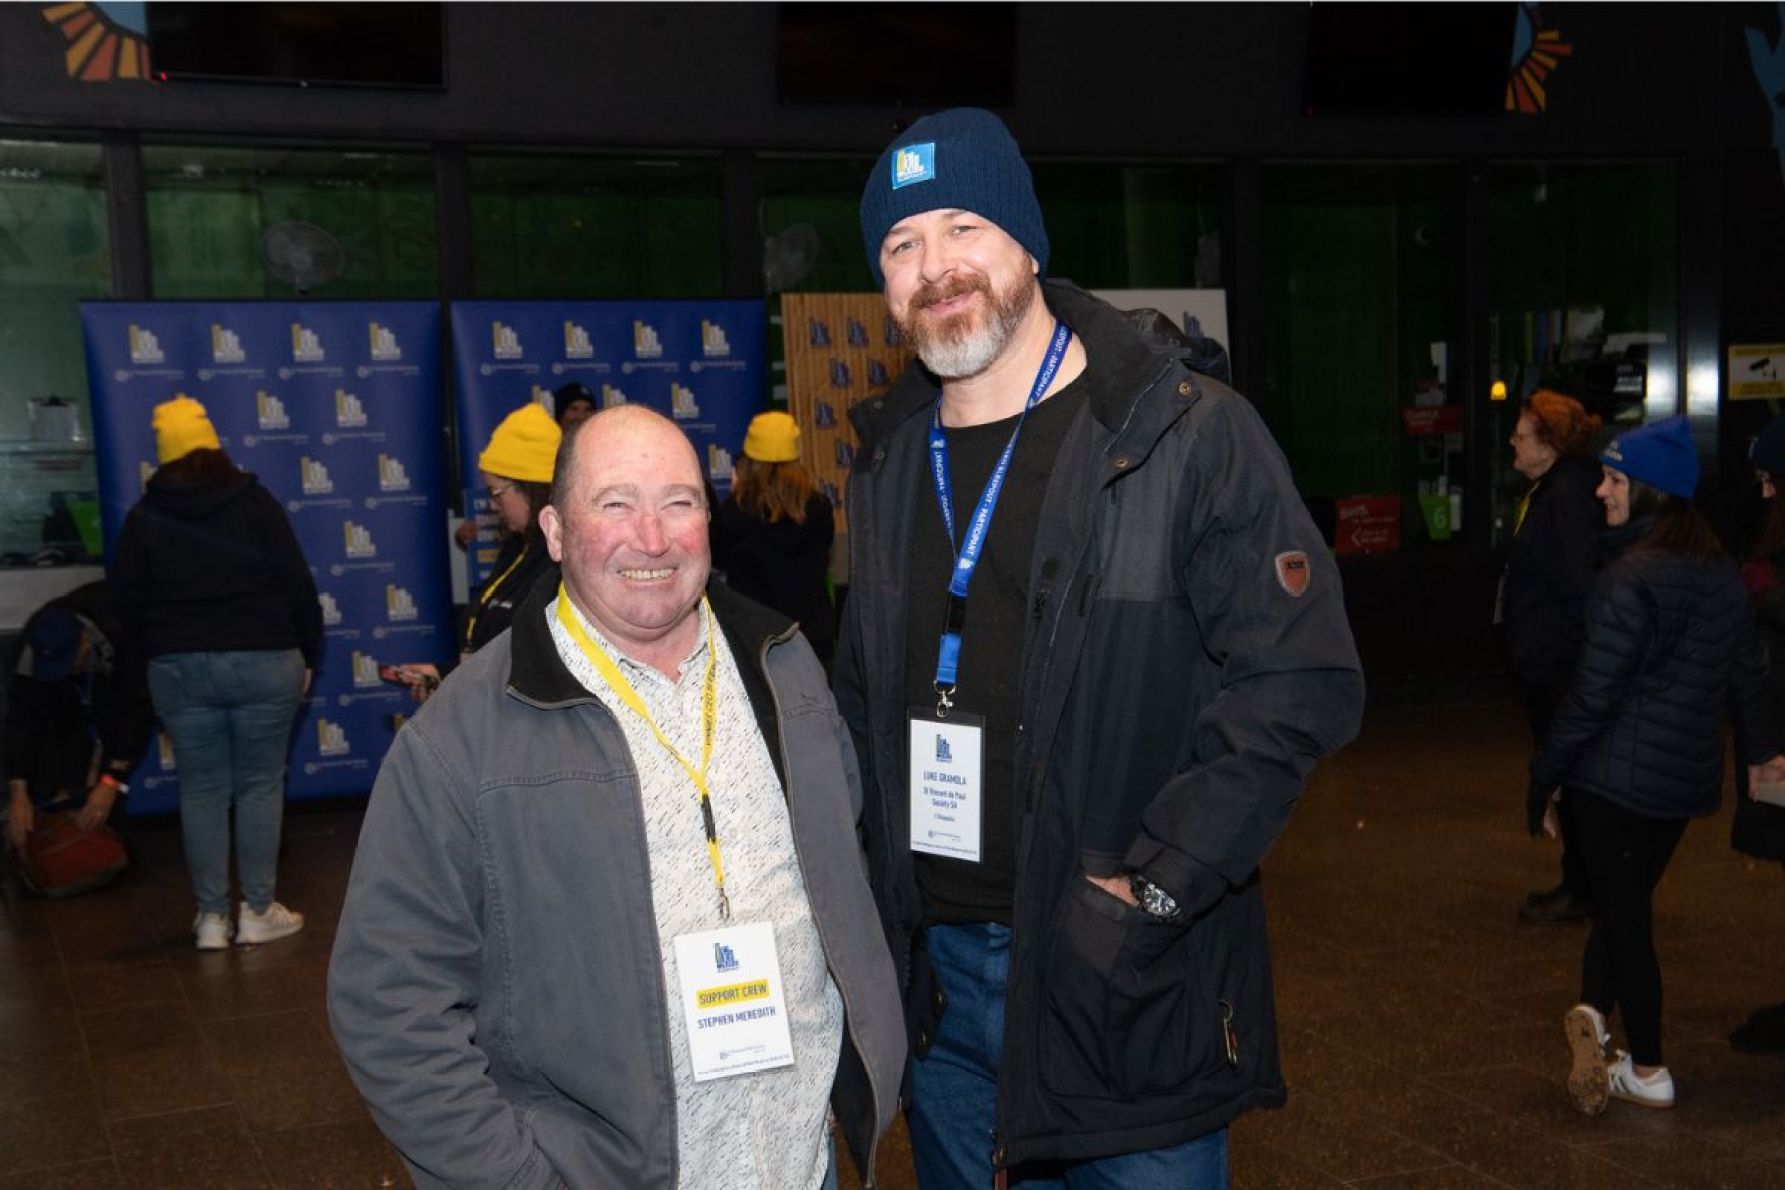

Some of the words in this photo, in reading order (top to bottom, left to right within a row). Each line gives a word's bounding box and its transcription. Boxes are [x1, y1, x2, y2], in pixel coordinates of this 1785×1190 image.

[967, 508, 991, 555] PARTICIPANT
[700, 988, 740, 1005] SUPPORT
[742, 983, 767, 997] CREW
[698, 1014, 734, 1029] STEPHEN
[736, 1006, 776, 1022] MEREDITH
